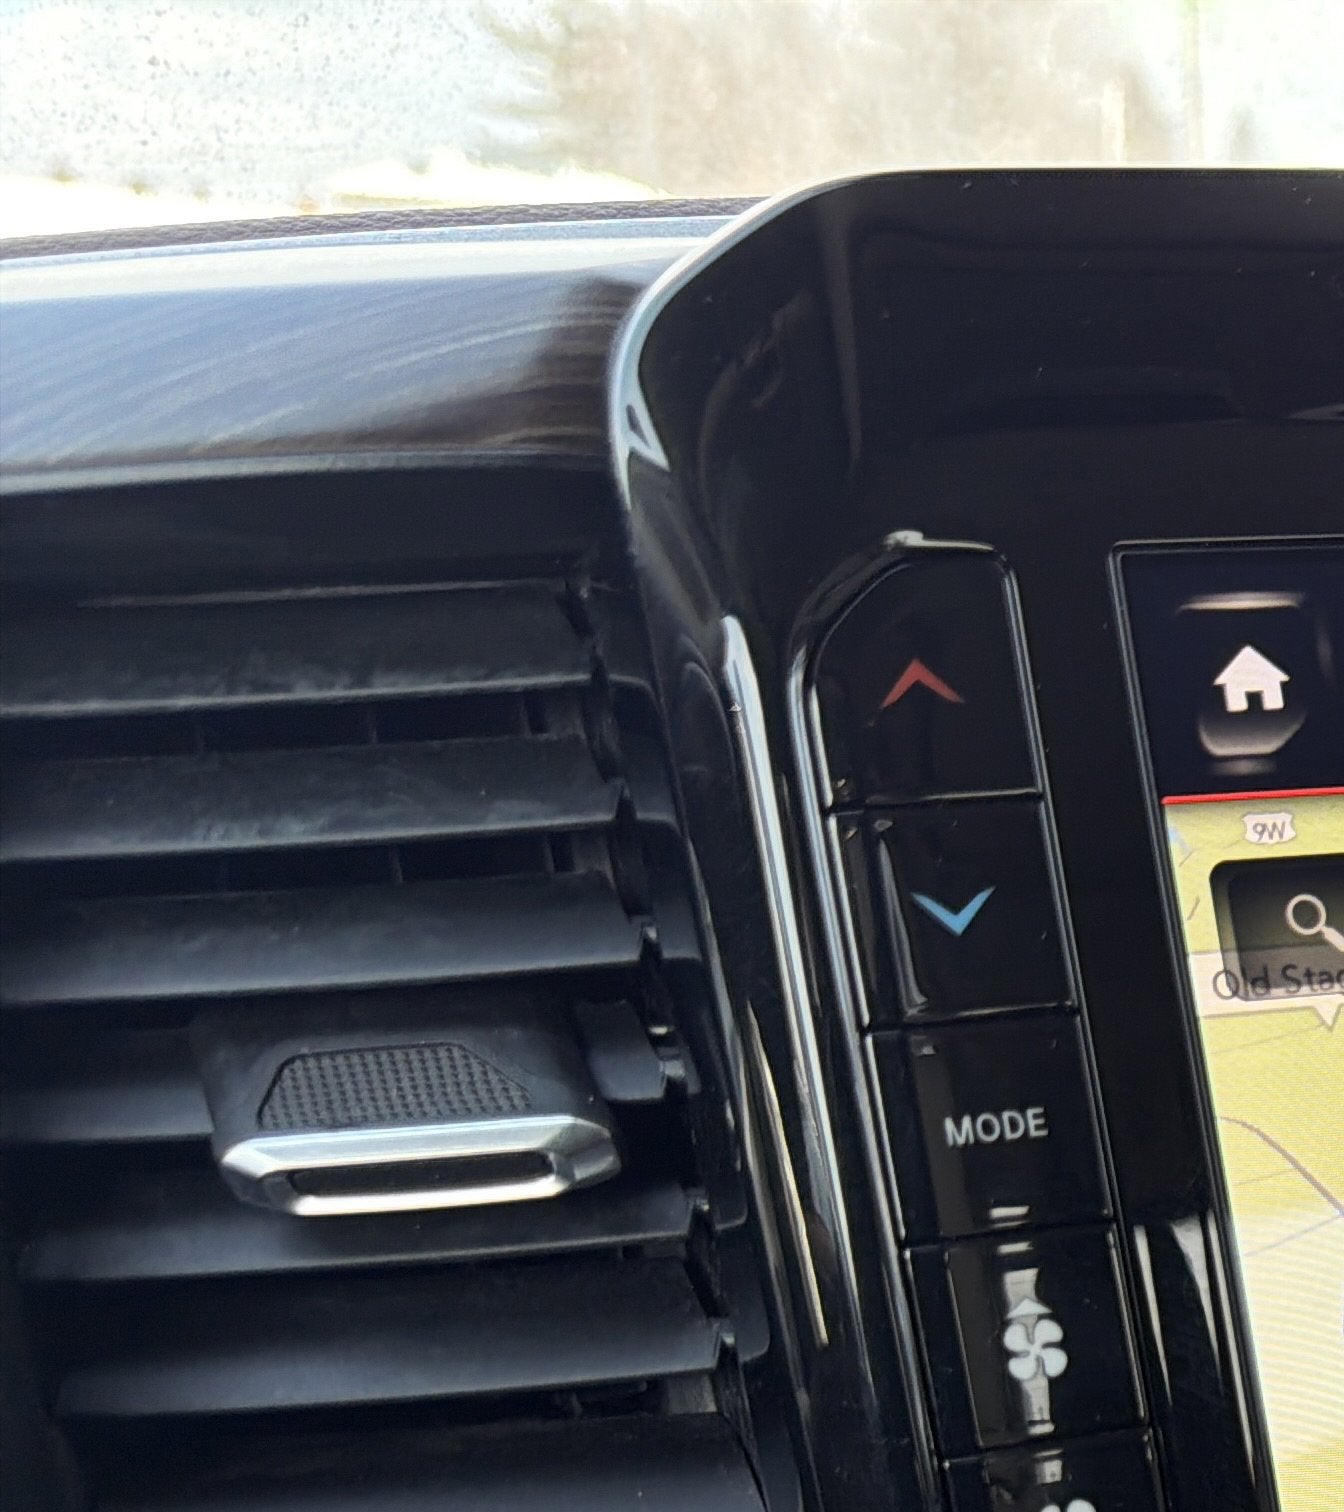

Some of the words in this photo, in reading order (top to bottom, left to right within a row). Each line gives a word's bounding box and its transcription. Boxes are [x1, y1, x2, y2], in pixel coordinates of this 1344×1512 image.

[1252, 820, 1286, 843] 9W
[1212, 965, 1271, 1000] Old
[944, 1106, 1049, 1148] MODE
